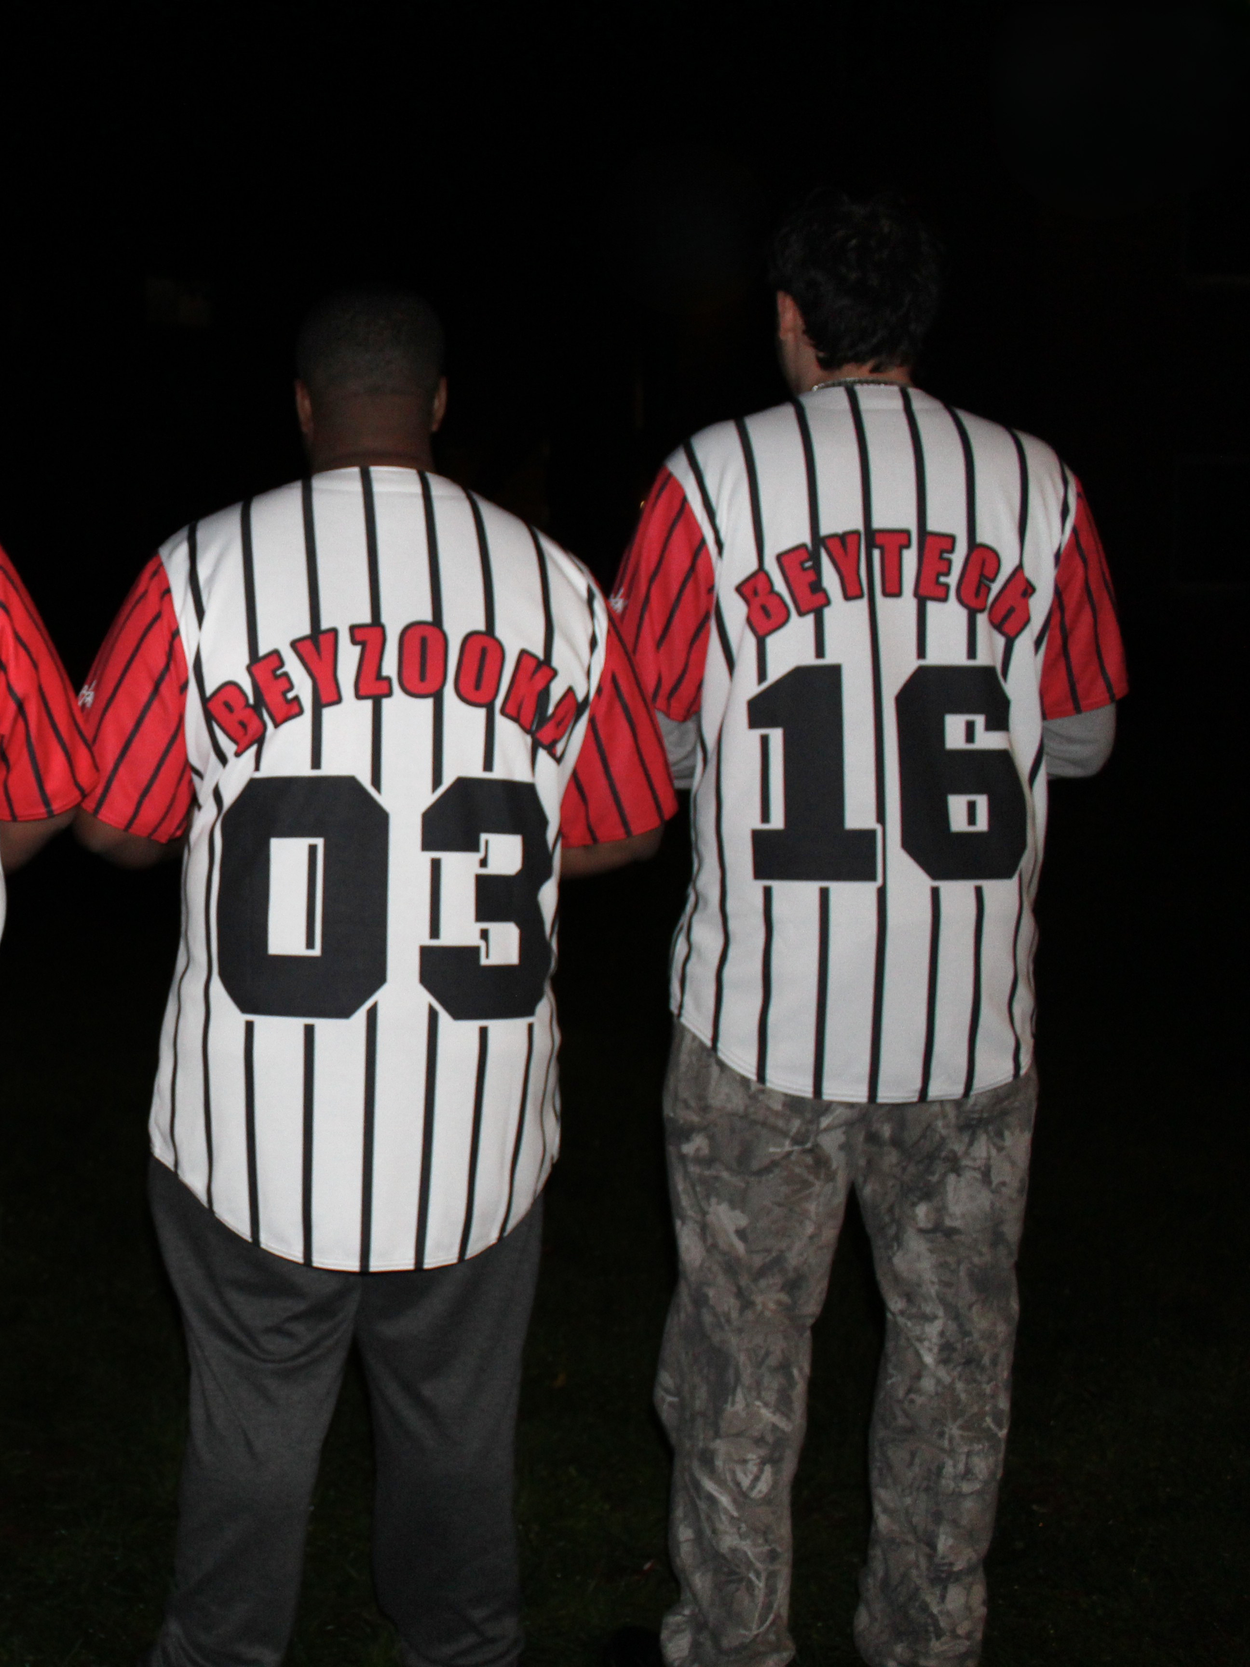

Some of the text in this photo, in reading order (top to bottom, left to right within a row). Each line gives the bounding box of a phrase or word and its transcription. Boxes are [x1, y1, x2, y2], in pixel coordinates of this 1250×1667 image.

[735, 528, 1036, 640] BEYTECH
[205, 621, 580, 762] BEYZOOKA
[747, 663, 1028, 882] 16
[217, 775, 553, 1021] 03
